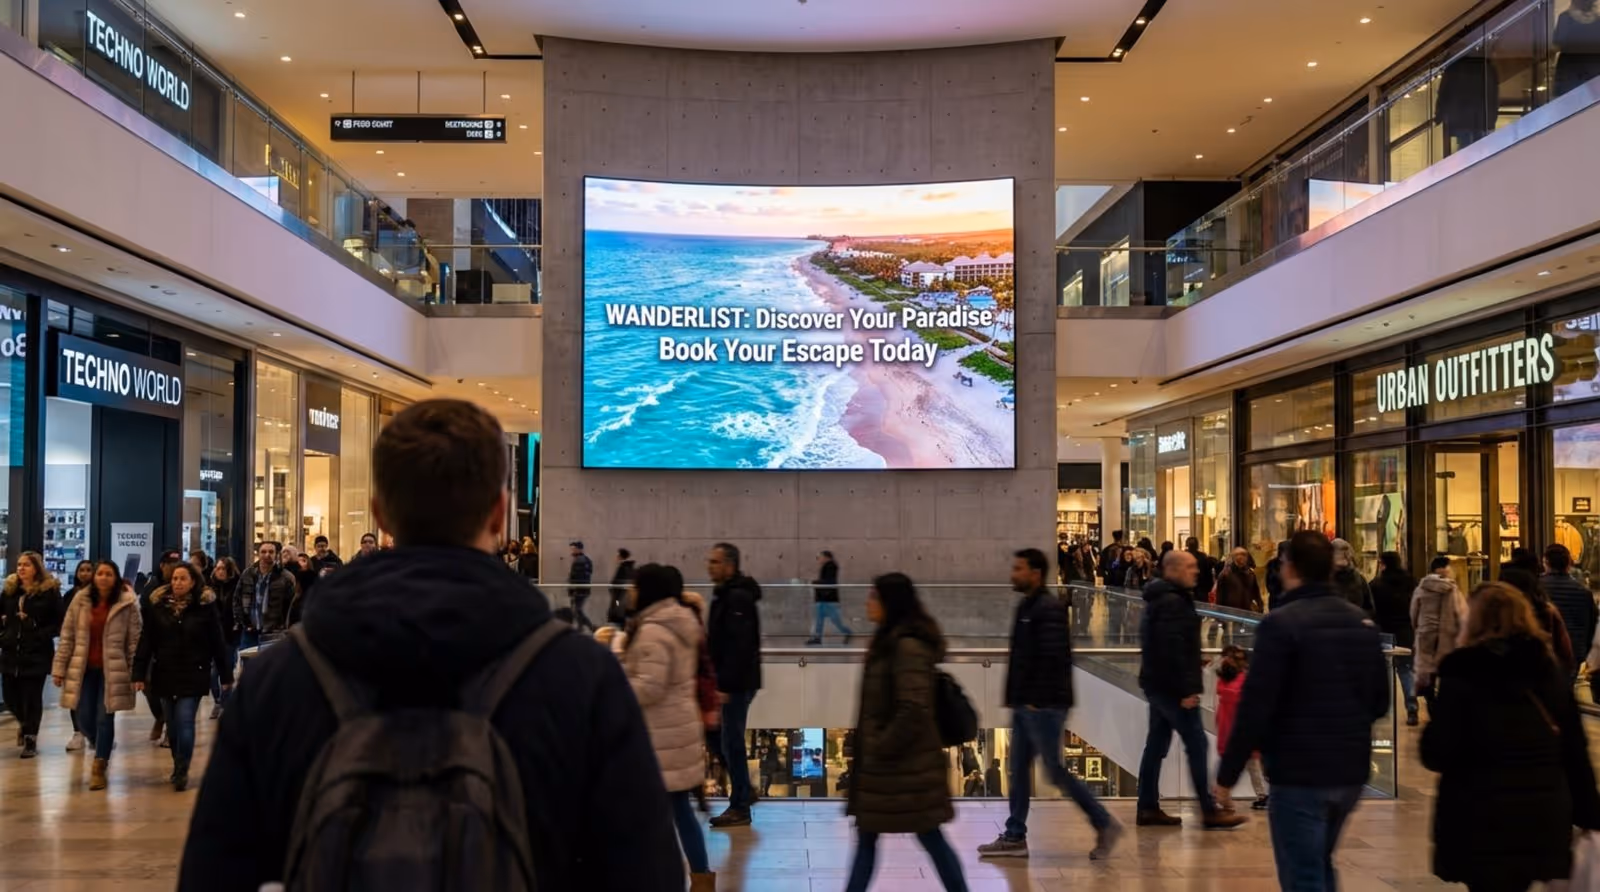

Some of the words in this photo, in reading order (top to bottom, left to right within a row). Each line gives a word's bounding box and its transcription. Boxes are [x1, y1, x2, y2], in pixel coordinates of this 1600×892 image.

[87, 10, 143, 78] TECHNO
[146, 55, 189, 110] WORLD
[605, 303, 750, 329] WANDERLIST:
[756, 307, 844, 329] Discover
[849, 308, 897, 329] Your
[902, 305, 993, 328] Paradise
[63, 349, 130, 395] TECHNO
[133, 367, 181, 405] WORLD
[659, 336, 718, 361] Book
[724, 338, 777, 362] Your
[782, 338, 864, 368] Escape
[869, 338, 938, 368] Today
[1377, 364, 1429, 413] URBAN
[1435, 333, 1554, 402] OUTFITTERS
